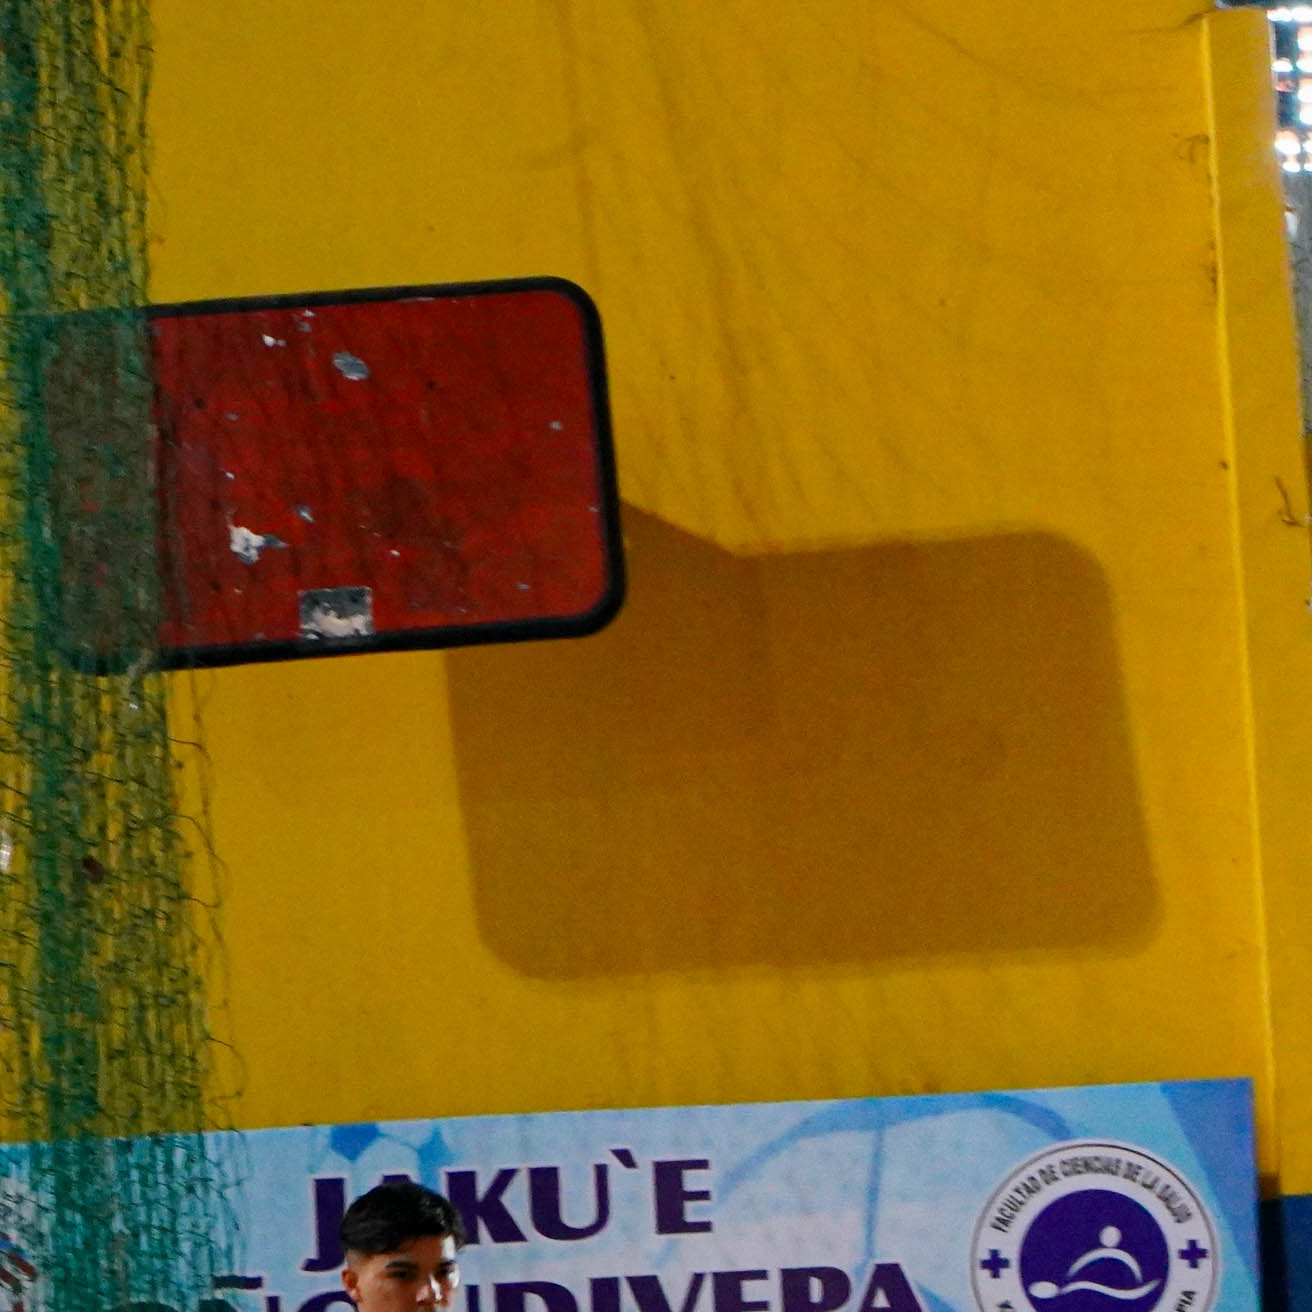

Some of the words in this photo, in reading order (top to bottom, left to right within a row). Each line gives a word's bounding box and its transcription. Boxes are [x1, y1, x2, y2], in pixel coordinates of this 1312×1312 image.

[303, 1148, 714, 1272] JKU`E
[990, 1175, 1042, 1234] FACULTAD
[1038, 1163, 1061, 1186] DE
[1059, 1156, 1122, 1179] CIENCIAS
[1122, 1161, 1144, 1181] DE
